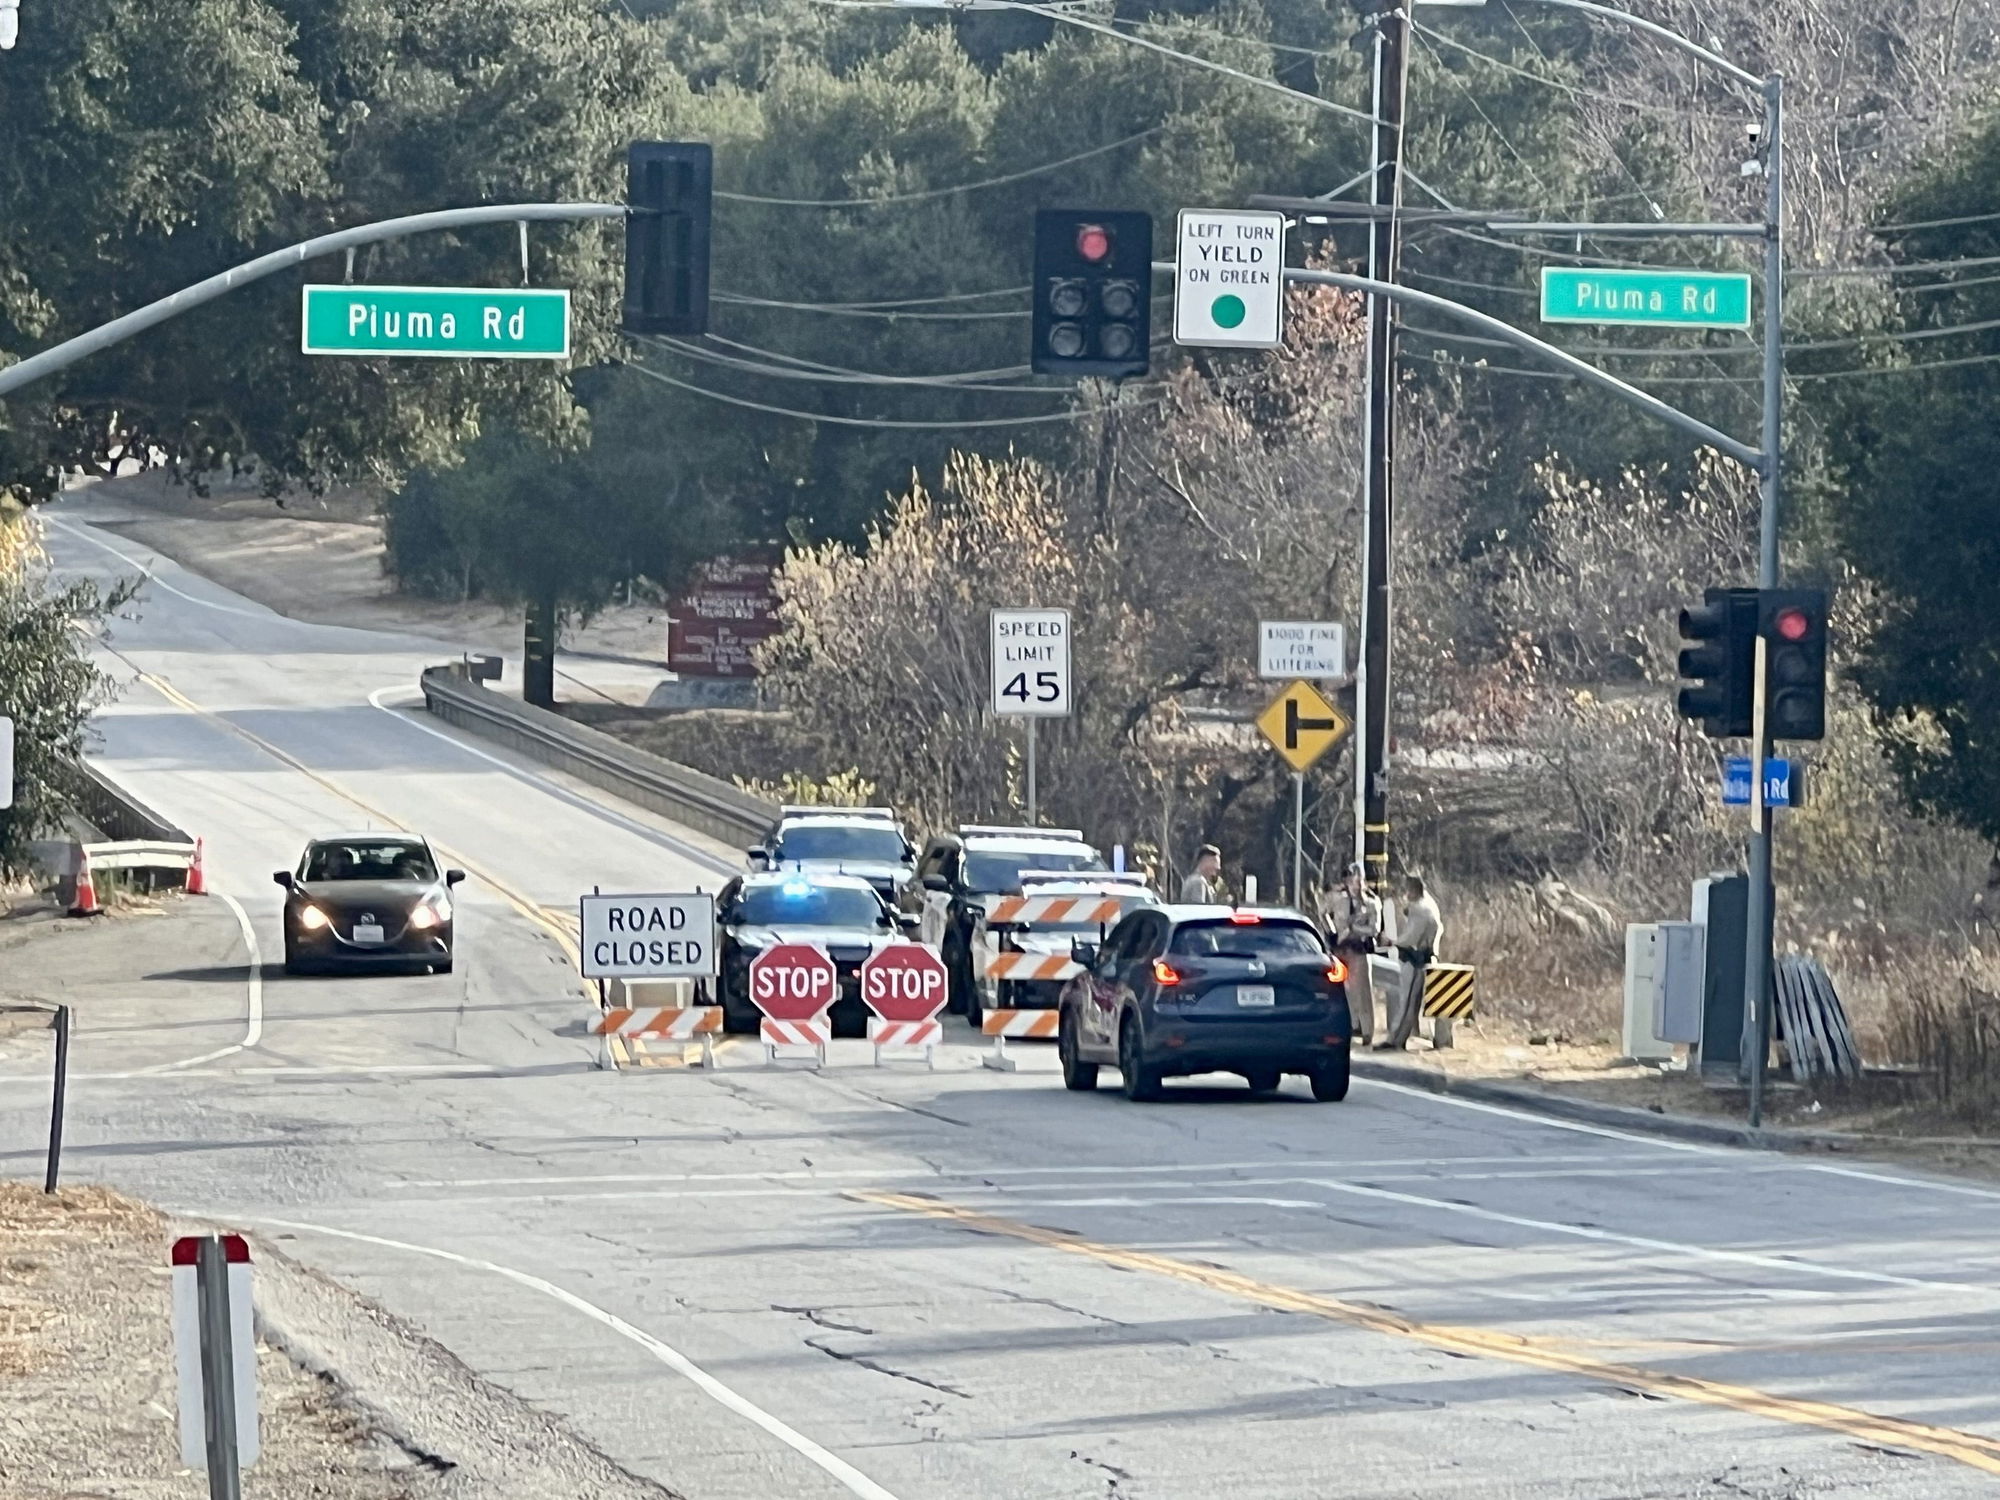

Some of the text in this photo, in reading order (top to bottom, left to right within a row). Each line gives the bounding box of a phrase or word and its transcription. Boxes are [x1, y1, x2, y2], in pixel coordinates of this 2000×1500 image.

[1188, 222, 1274, 240] LEFT TURN
[1198, 244, 1263, 263] YIELD
[1189, 268, 1270, 284] ON GREEN
[1577, 282, 1716, 314] Piuma Rd
[348, 304, 525, 341] Piuma Rd
[999, 621, 1062, 638] SPEED
[1005, 646, 1055, 661] LIMIT
[1290, 643, 1315, 656] FOR
[1001, 671, 1060, 703] 45
[608, 906, 687, 932] ROAD
[594, 941, 703, 966] CLOSED
[755, 965, 830, 1000] STOP
[868, 966, 942, 1000] STOP
